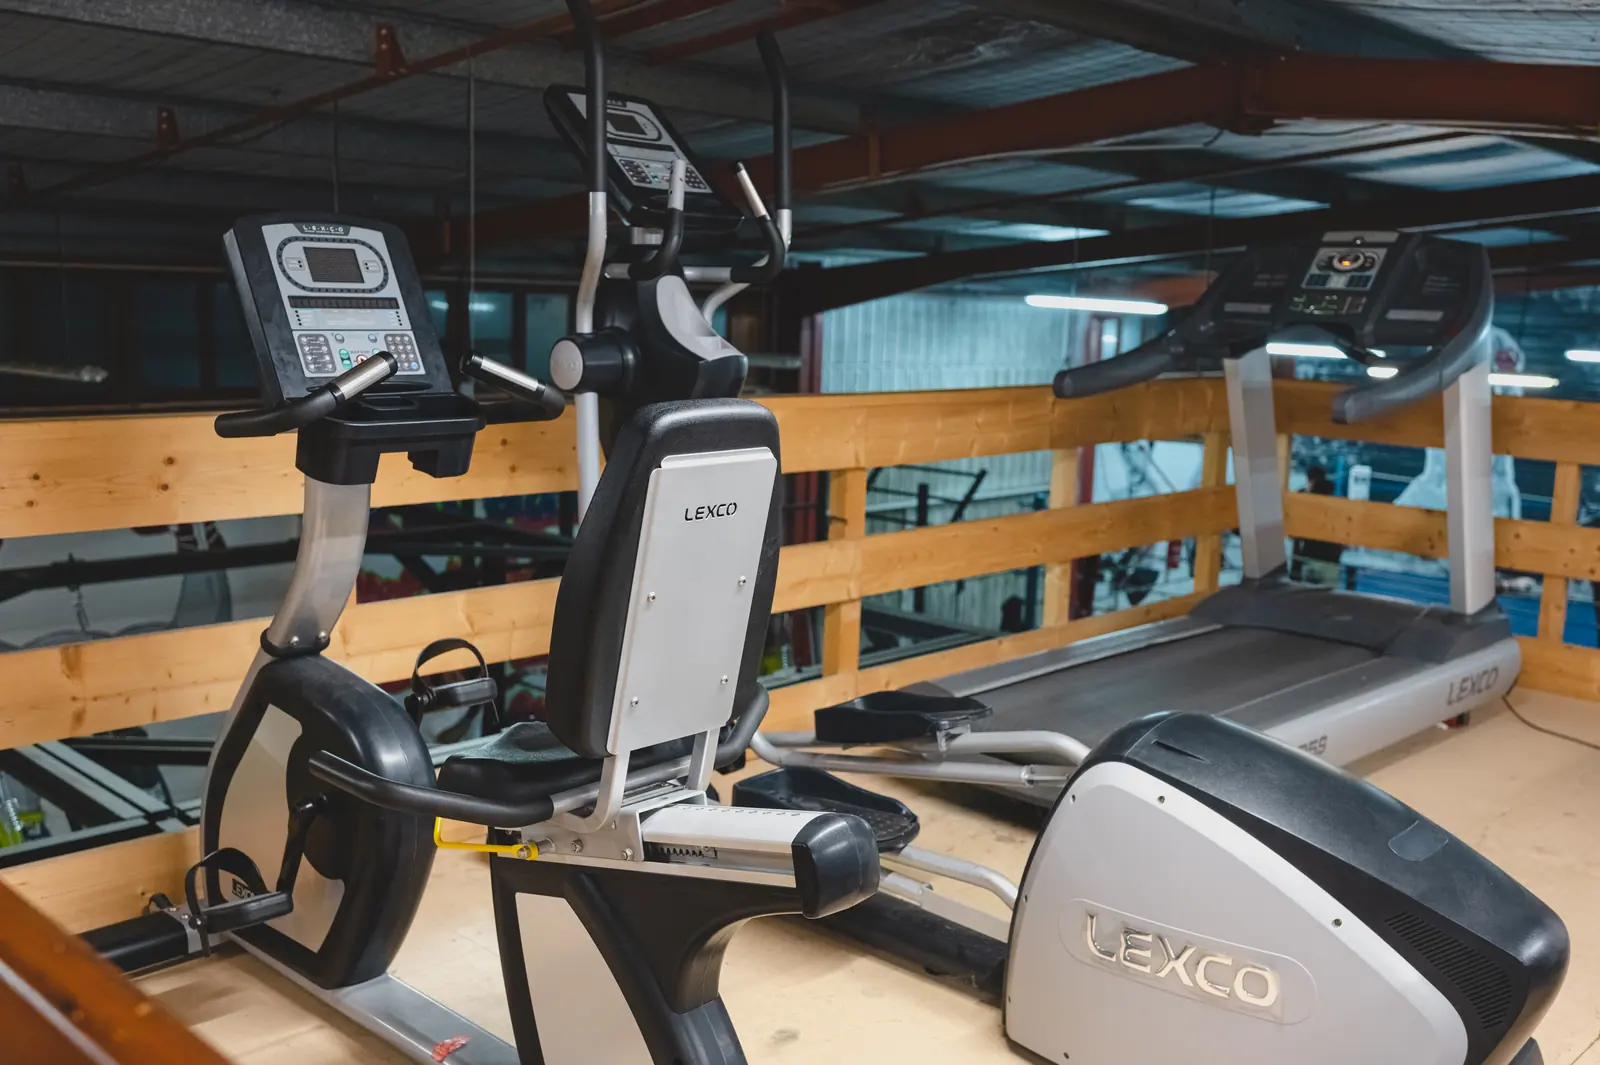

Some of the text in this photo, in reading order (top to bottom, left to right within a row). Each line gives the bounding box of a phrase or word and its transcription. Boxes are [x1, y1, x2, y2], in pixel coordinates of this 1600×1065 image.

[684, 502, 737, 521] LEXCO
[1447, 667, 1499, 706] LEXCO
[1086, 913, 1280, 1007] LEXCO
